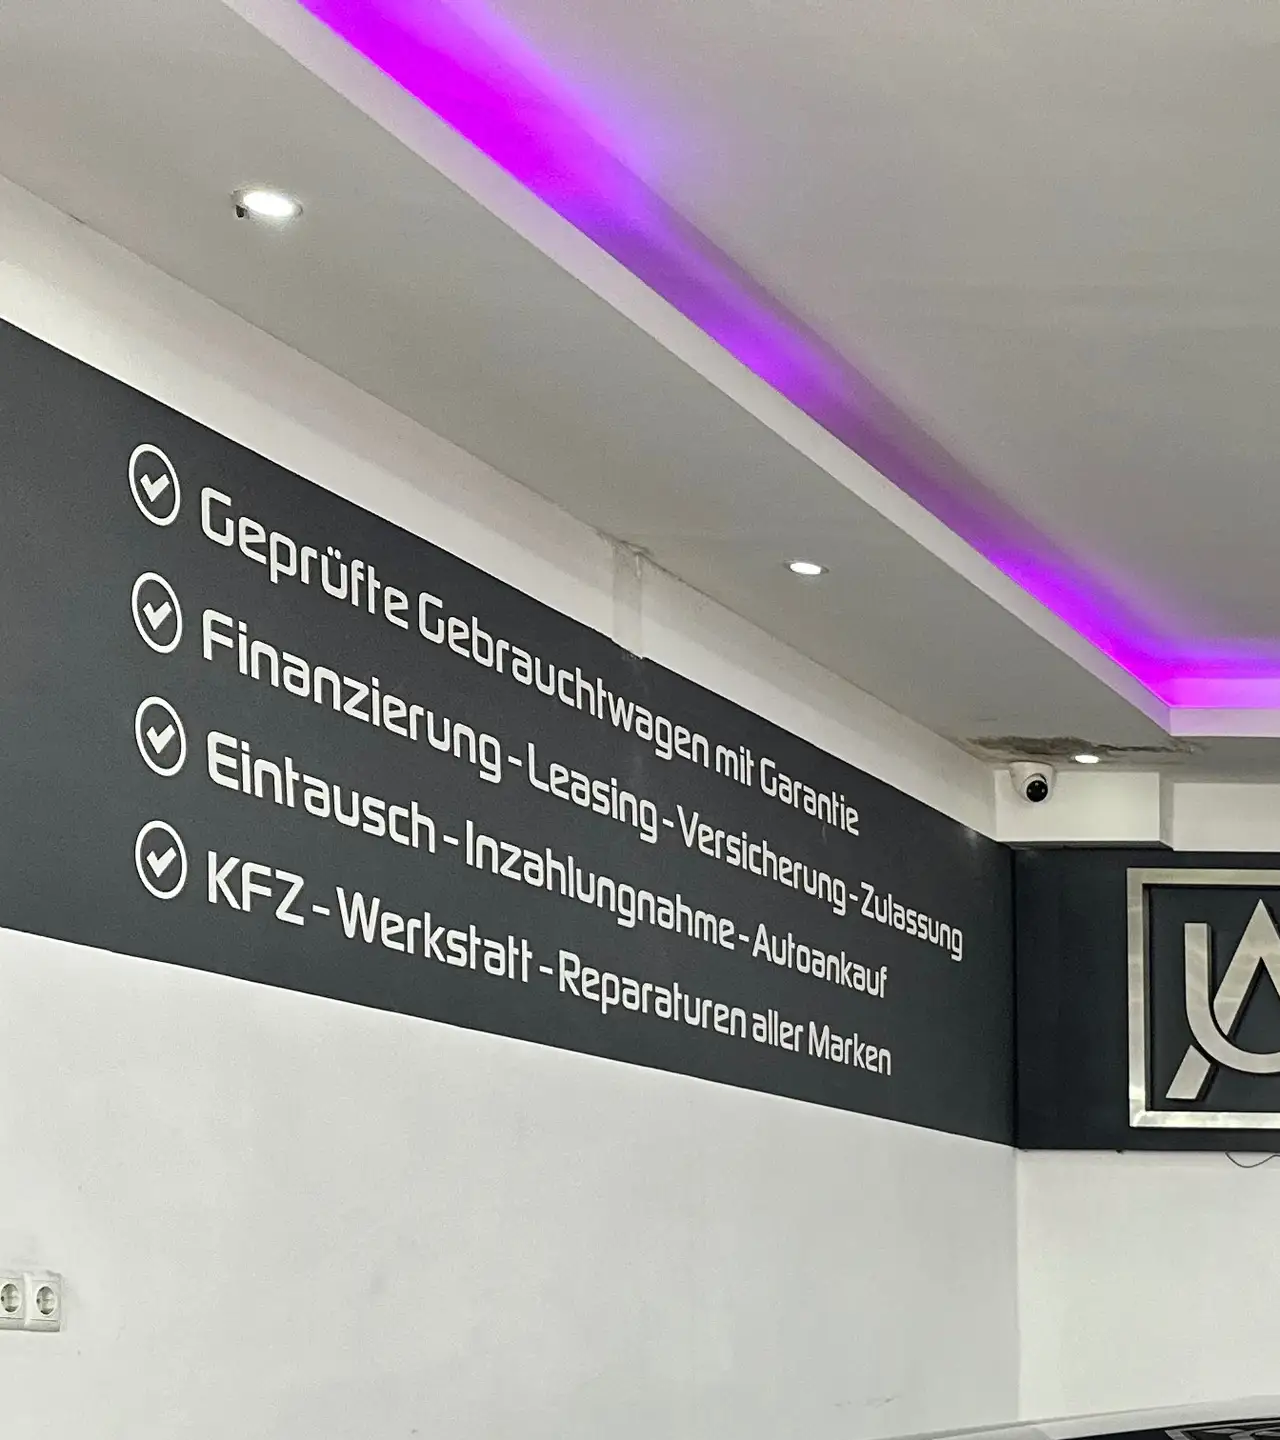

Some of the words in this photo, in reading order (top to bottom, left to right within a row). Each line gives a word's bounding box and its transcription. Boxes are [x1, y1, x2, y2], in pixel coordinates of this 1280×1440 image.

[202, 488, 408, 629] Geprüfte
[419, 593, 709, 767] Gebrauchtwagen
[715, 745, 755, 787] mit
[761, 758, 859, 836] Garantie
[203, 610, 502, 784] Finanzierung
[528, 743, 658, 844] Leasing
[677, 805, 845, 917] Versicherung
[861, 882, 963, 962] Zulassung
[208, 732, 435, 853] Eintausch
[467, 820, 734, 951] Inzahlungnahme
[753, 924, 888, 998] Autoankauf
[208, 851, 305, 926] KFZ
[336, 887, 532, 983] Werkstatt
[559, 950, 746, 1039] Reparaturen
[753, 1013, 804, 1052] aller
[809, 1021, 892, 1076] Marken
